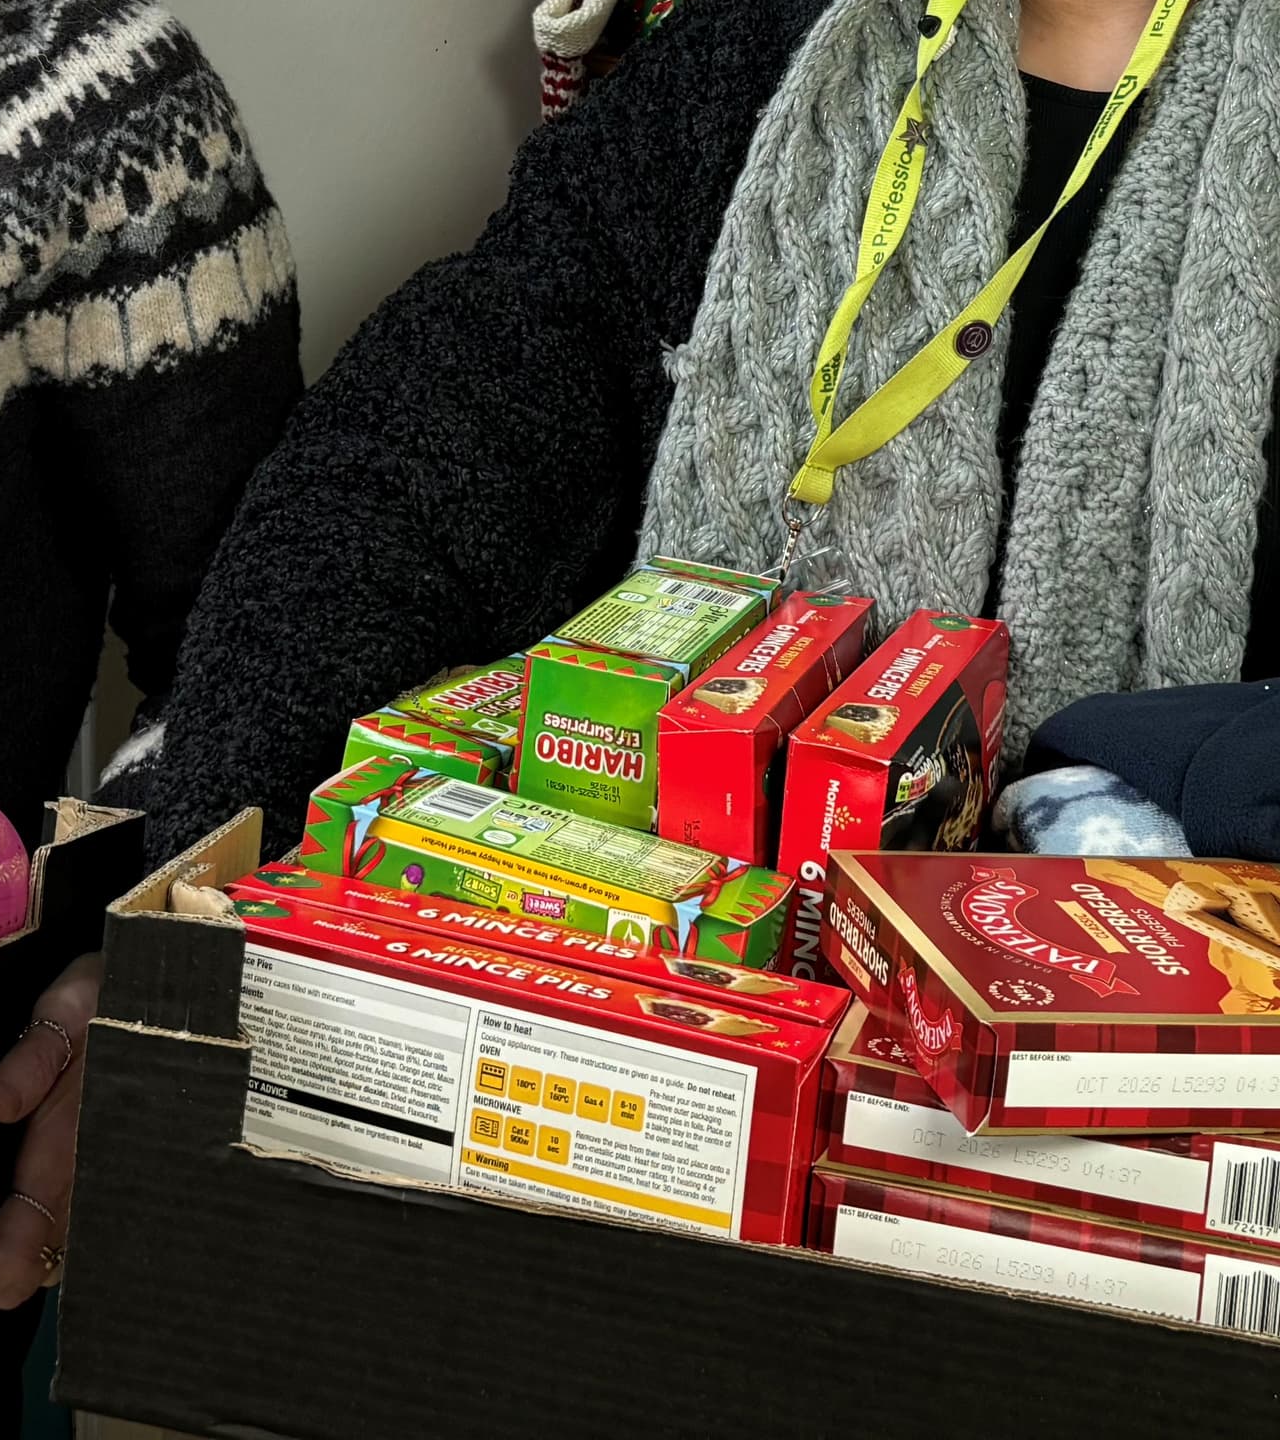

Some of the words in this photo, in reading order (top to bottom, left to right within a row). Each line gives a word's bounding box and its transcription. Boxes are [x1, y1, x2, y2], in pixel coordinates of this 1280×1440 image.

[871, 148, 913, 247] Professio
[881, 652, 923, 682] MINCE
[427, 670, 525, 710] HARIBO
[867, 679, 902, 701] PIES
[543, 712, 615, 743] Surprises
[535, 732, 645, 783] HARIBO
[540, 805, 571, 822] 120
[820, 779, 840, 851] Morrisons
[458, 846, 478, 859] world
[478, 850, 502, 866] happy
[503, 859, 514, 870] the
[800, 860, 826, 882] 6
[533, 870, 549, 883] love
[549, 871, 588, 893] grown-ups
[344, 889, 412, 909] Morrisons
[588, 885, 603, 896] and
[847, 897, 876, 939] FINGERS
[968, 880, 1100, 974] PATERSON'S
[1071, 882, 1190, 976] SHORTBREAD
[1130, 907, 1186, 949] FINGERS
[313, 918, 382, 941] Morrisons
[416, 907, 441, 920] 6
[443, 911, 556, 944] MINCE
[563, 935, 638, 960] PIES
[792, 887, 824, 981] MINC
[829, 902, 889, 987] SHORTBREAD
[385, 941, 410, 953] 6
[411, 947, 526, 981] MINCE
[533, 973, 613, 1000] PIES
[442, 944, 491, 959] RICH
[513, 959, 586, 982] FRUITY
[906, 974, 953, 1050] PATERSON'S
[483, 1015, 502, 1029] How
[504, 1021, 512, 1031] to
[514, 1023, 532, 1036] heat
[480, 1044, 501, 1056] OVEN
[1012, 1053, 1028, 1061] BEST
[1029, 1053, 1054, 1062] BEFORE
[481, 1032, 506, 1047] Cooking
[508, 1038, 541, 1056] appliances
[543, 1047, 558, 1060] vary.
[560, 1050, 579, 1063] These
[581, 1055, 617, 1073] instructions
[631, 1068, 649, 1081] given
[666, 1077, 686, 1091] guide.
[687, 1082, 698, 1092] Do
[699, 1084, 711, 1095] not
[712, 1087, 737, 1101] reheat.
[516, 1078, 537, 1091] 180°C
[1076, 1076, 1108, 1094] OCT
[1118, 1076, 1161, 1093] 2026
[1171, 1075, 1225, 1094] L5293
[473, 1095, 521, 1115] MICROWAVE
[584, 1096, 597, 1106] Gas
[849, 1092, 867, 1103] BEST
[867, 1097, 893, 1109] BEFORE
[475, 1153, 510, 1171] Warning
[912, 1127, 945, 1148] OCT
[957, 1136, 1001, 1159] 2026
[1012, 1148, 1072, 1173] L5293
[1082, 1160, 1142, 1186] 04:37
[839, 1207, 856, 1217] BEST
[857, 1210, 882, 1223] BEFORE
[1233, 1220, 1271, 1237] 72417
[890, 1237, 926, 1259] OCT
[936, 1246, 984, 1272] 2026
[995, 1257, 1055, 1283] L5293
[1066, 1271, 1128, 1298] 04:37
